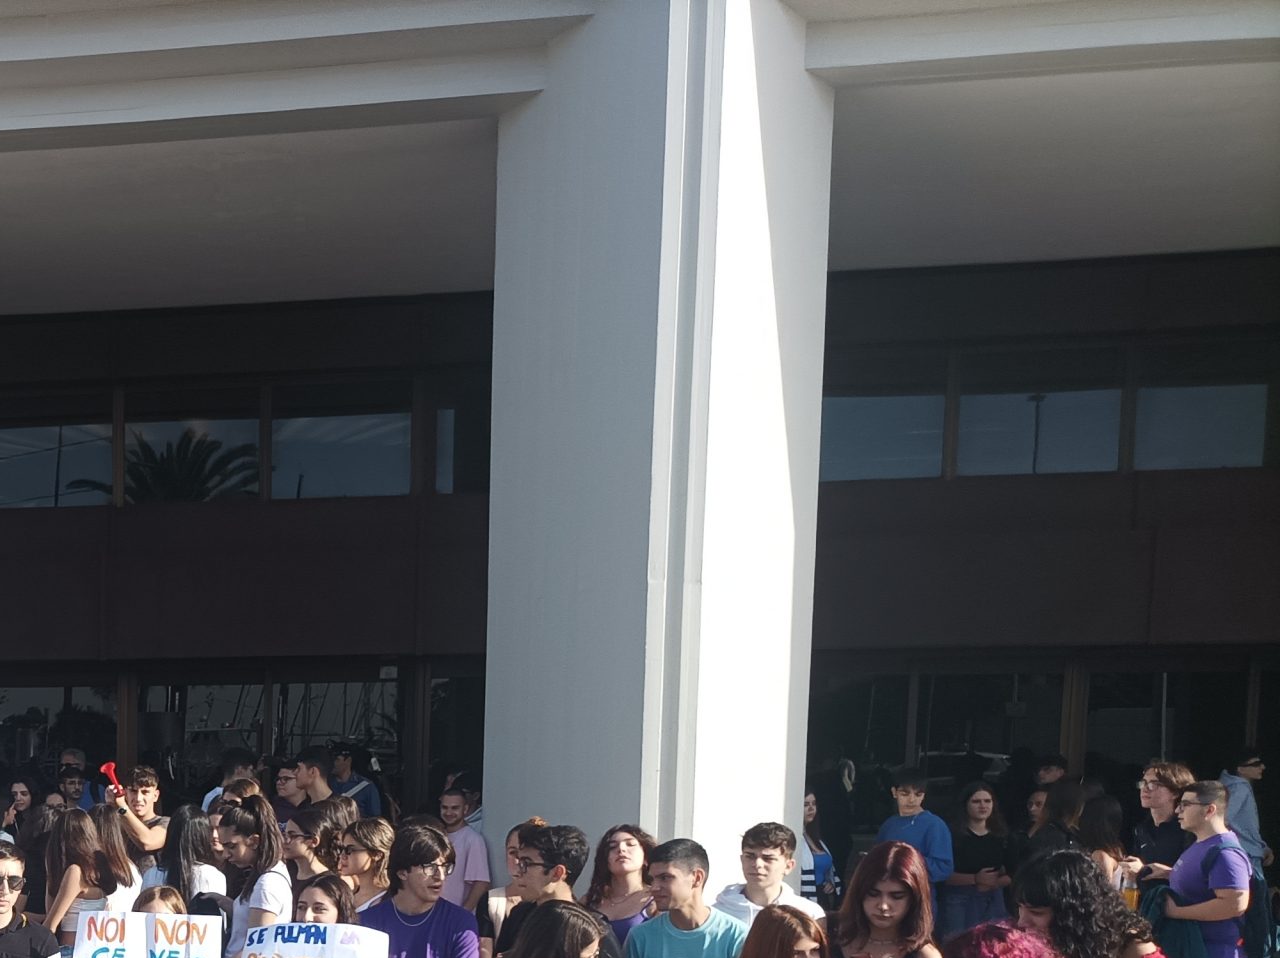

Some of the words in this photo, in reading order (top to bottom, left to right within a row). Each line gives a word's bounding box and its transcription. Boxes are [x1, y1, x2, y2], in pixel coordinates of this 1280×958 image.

[87, 916, 125, 943] NOI
[154, 919, 207, 945] NON
[246, 928, 268, 947] SE
